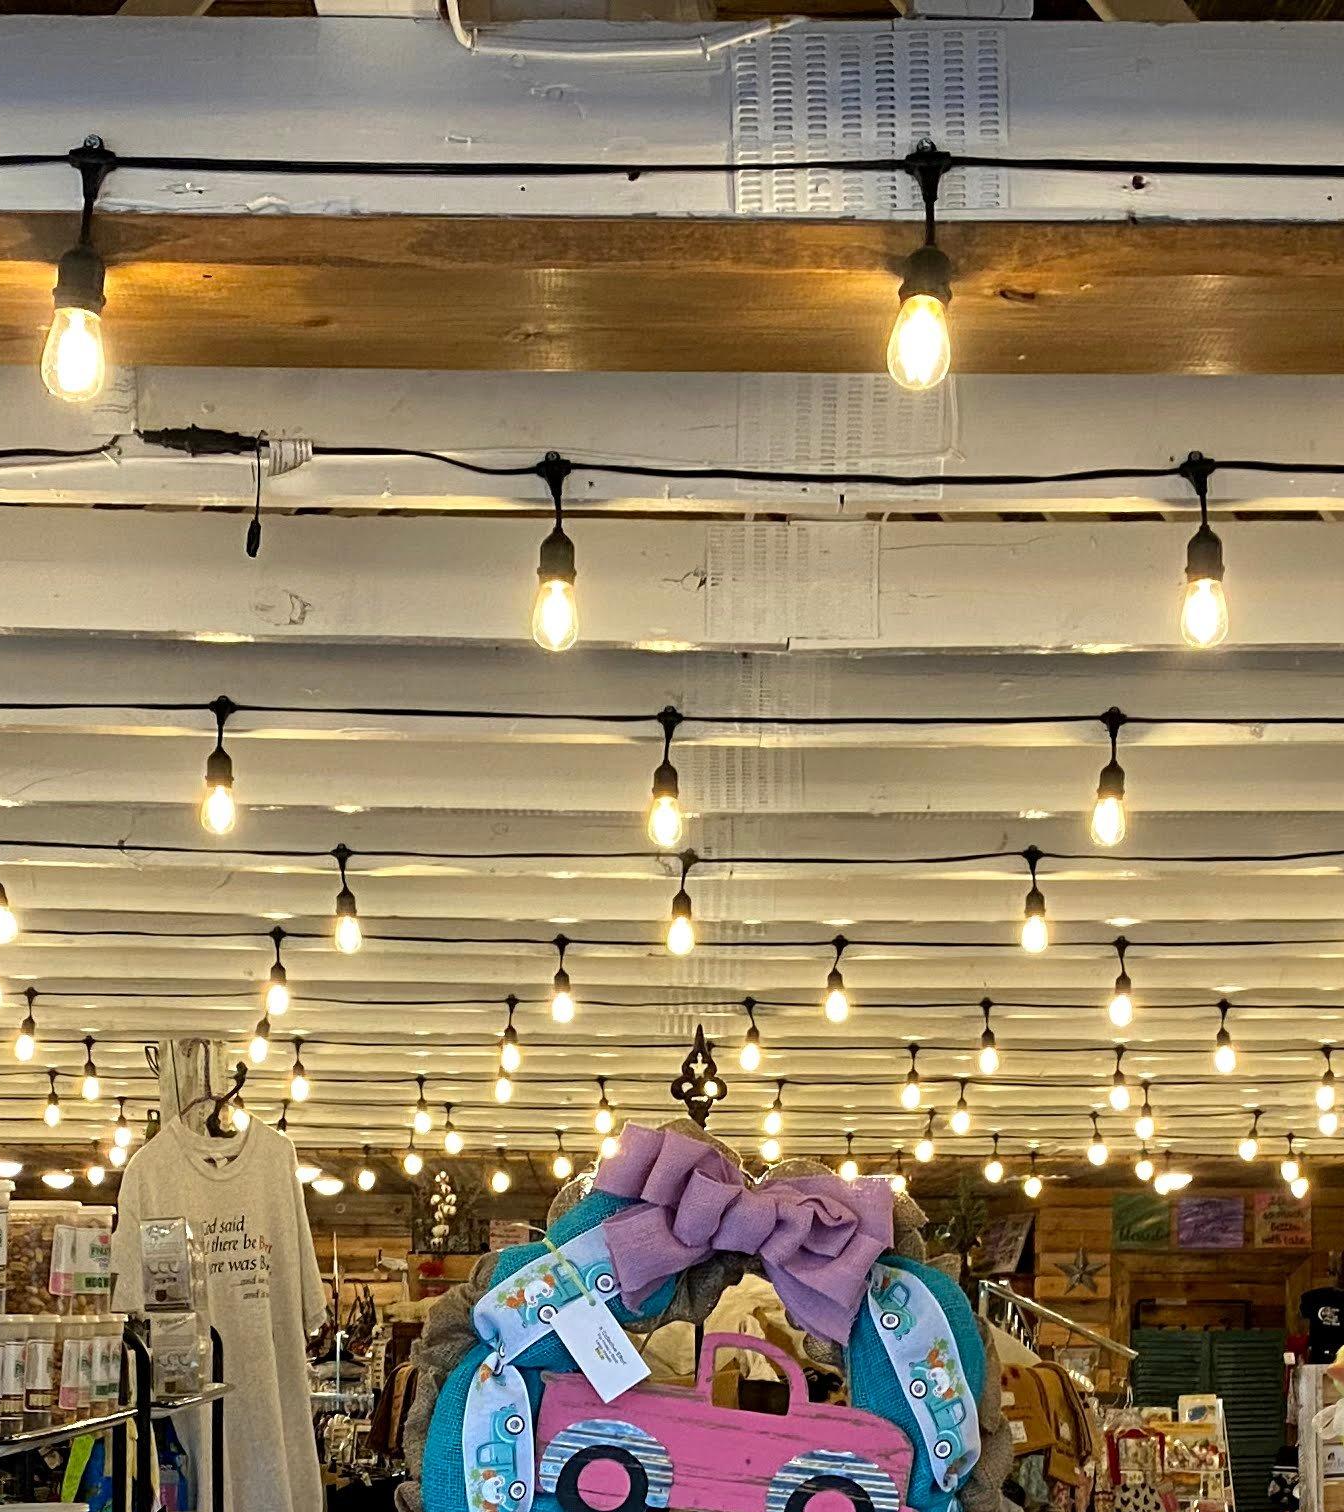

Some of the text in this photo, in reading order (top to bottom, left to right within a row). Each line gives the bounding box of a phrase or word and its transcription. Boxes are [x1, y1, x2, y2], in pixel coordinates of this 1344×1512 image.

[219, 1214, 246, 1234] said
[210, 1235, 239, 1254] there
[243, 1233, 257, 1251] be
[227, 1259, 257, 1274] was
